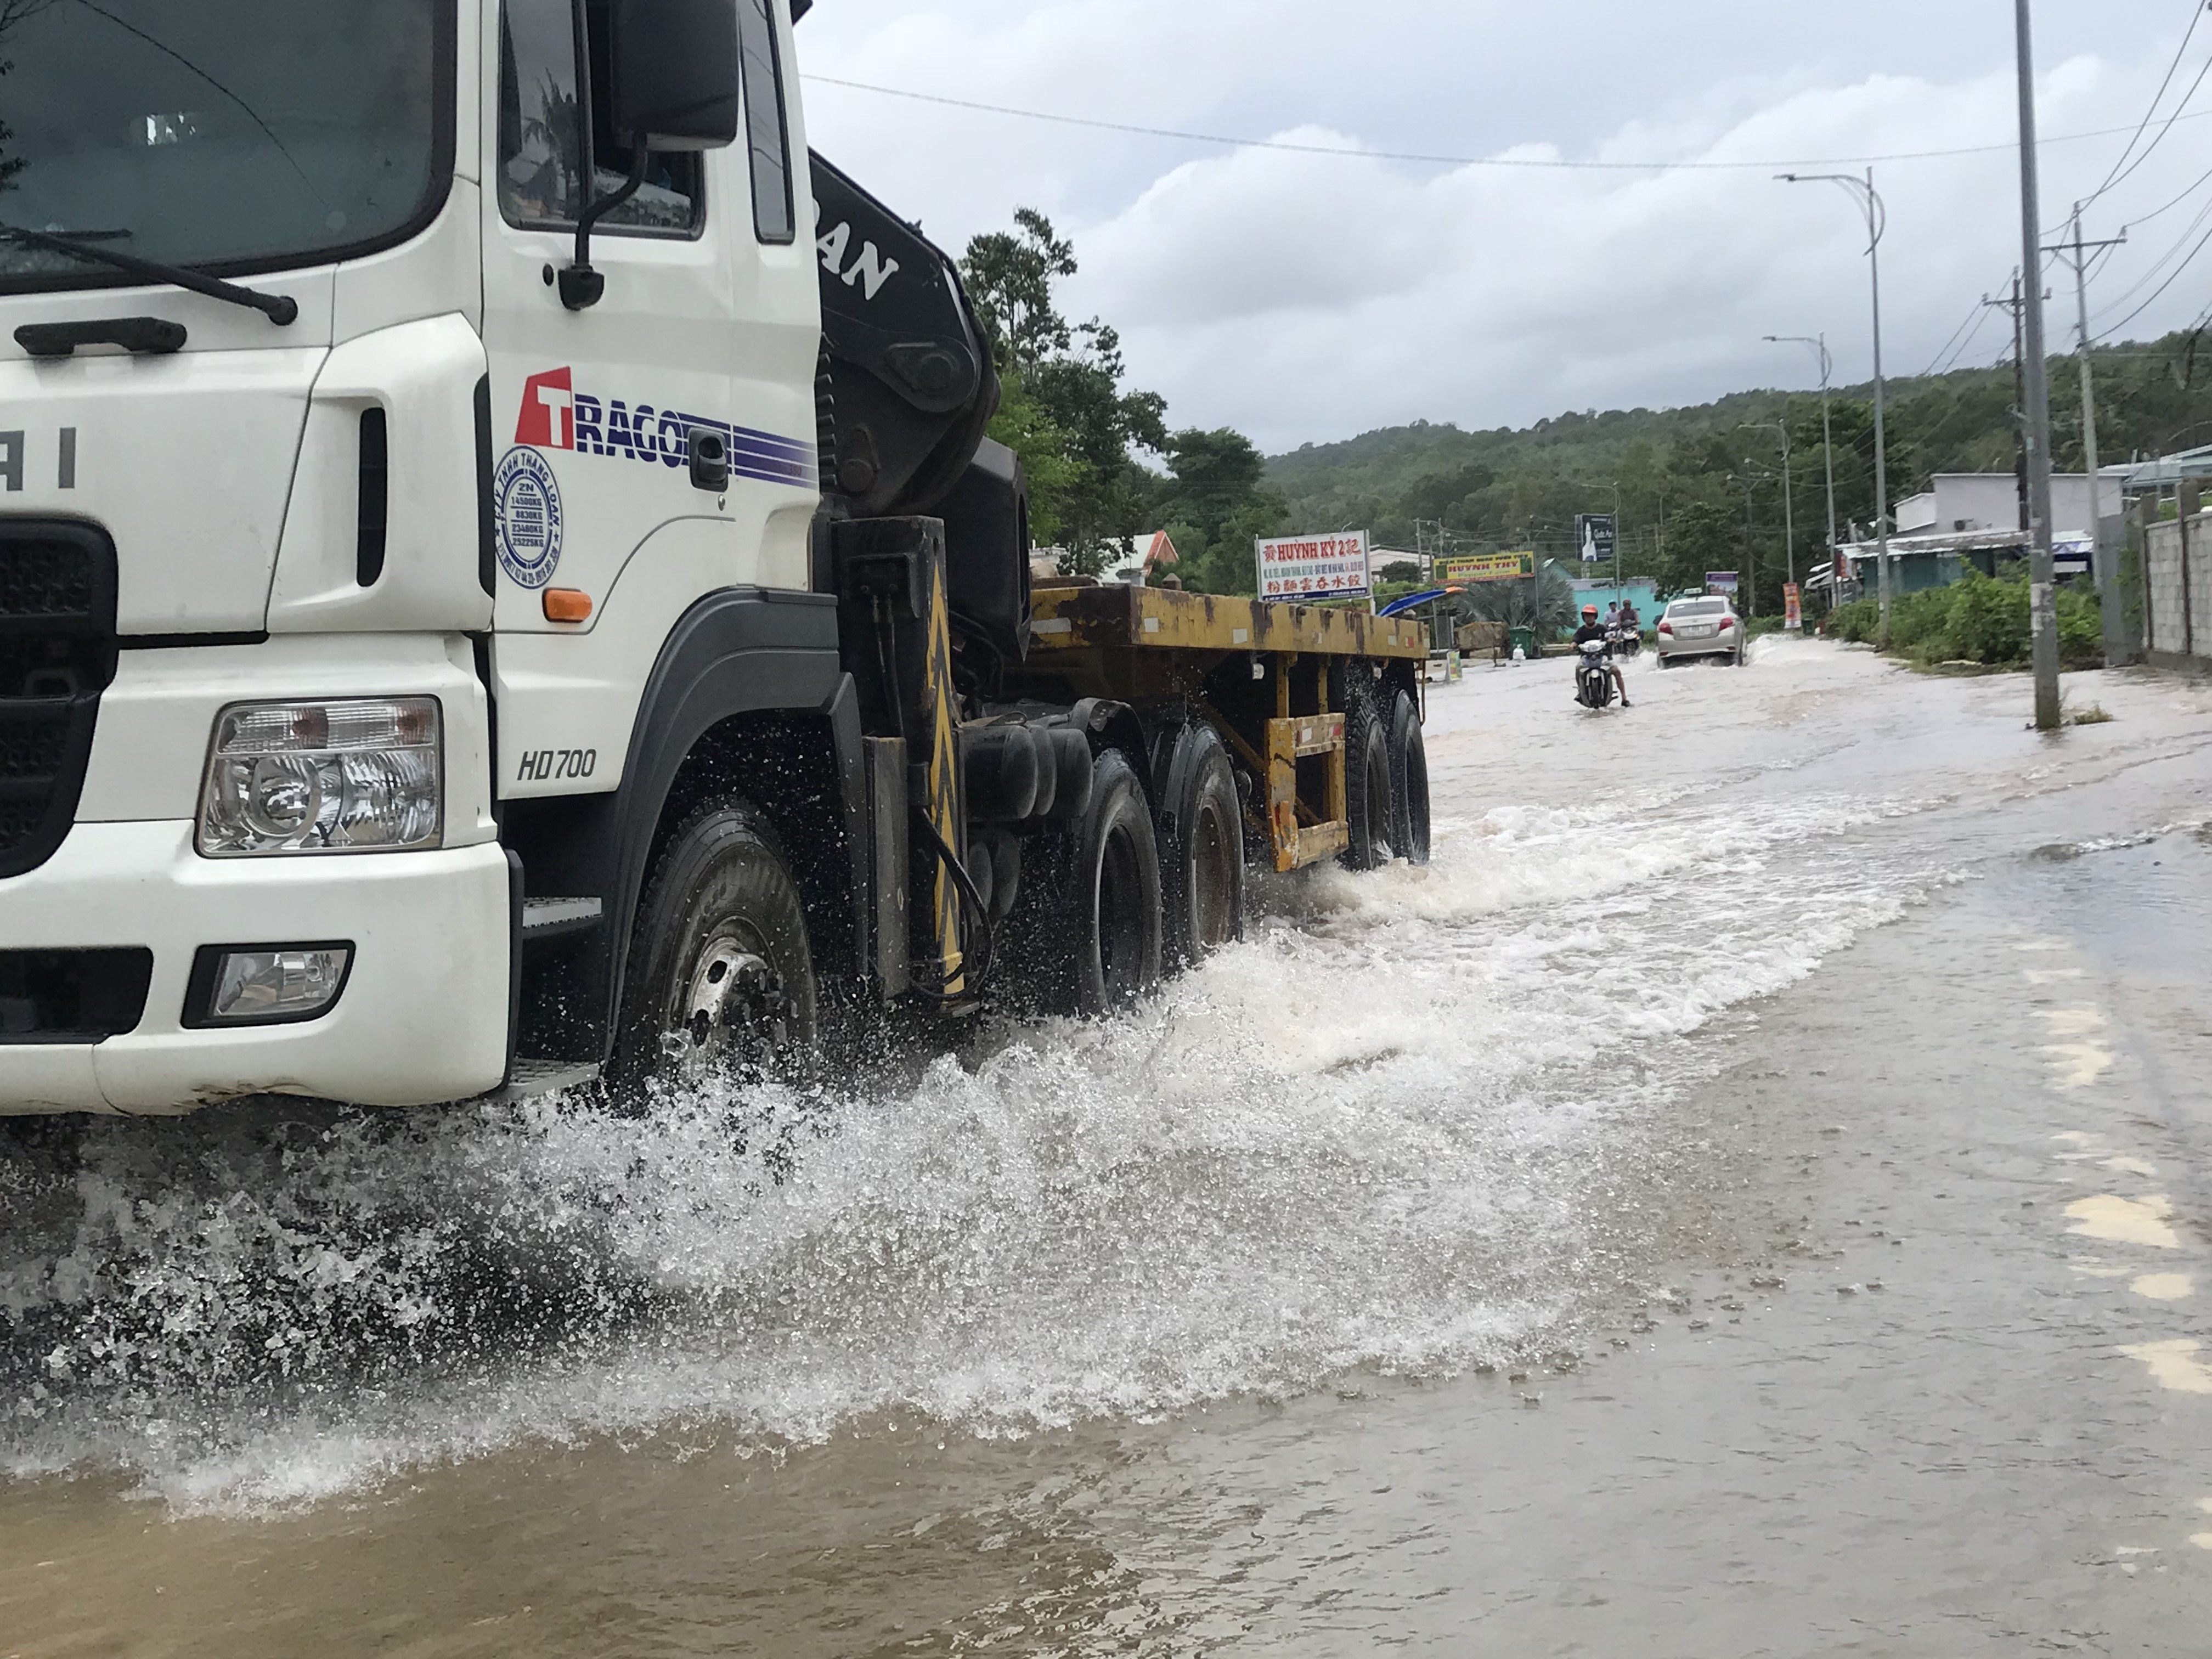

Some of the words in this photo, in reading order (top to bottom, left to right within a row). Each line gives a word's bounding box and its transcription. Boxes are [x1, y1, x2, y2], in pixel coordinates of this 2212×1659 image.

[519, 483, 534, 492] 2N
[1338, 540, 1346, 557] 2
[517, 748, 597, 781] HD700
